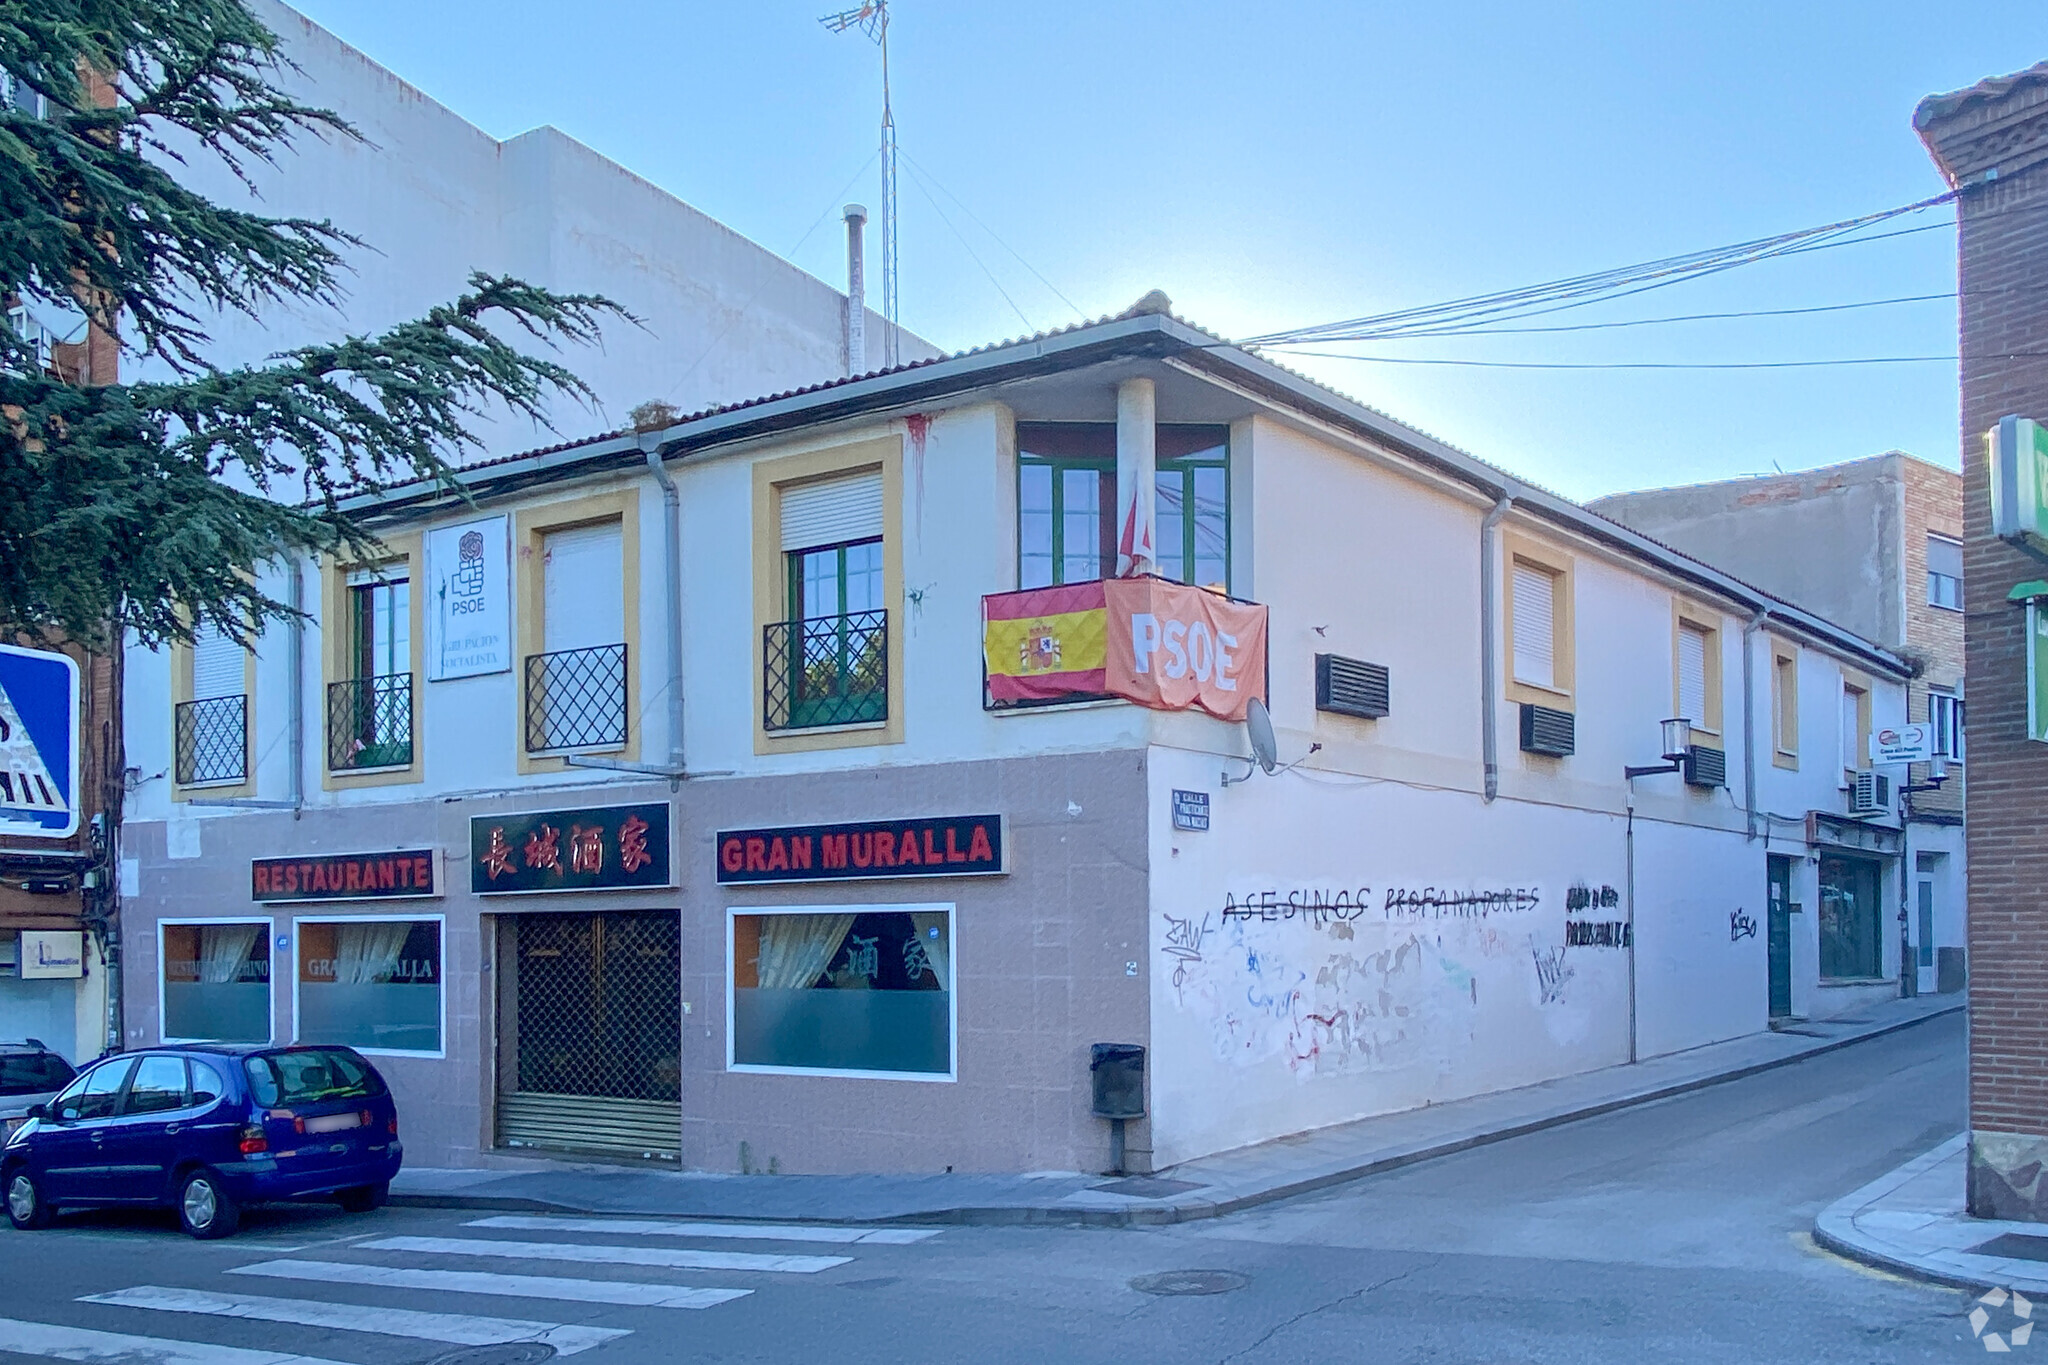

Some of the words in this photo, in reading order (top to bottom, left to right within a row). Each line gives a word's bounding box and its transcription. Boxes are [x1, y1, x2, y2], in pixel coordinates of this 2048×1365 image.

[452, 597, 485, 616] PSOE
[1131, 613, 1238, 692] PSOE
[722, 833, 812, 873] GRAN
[821, 823, 993, 869] MURALLA
[254, 858, 429, 893] RESTAURANTE
[1222, 888, 1371, 925] ASESINOS
[1385, 887, 1540, 920] PROFANADORES
